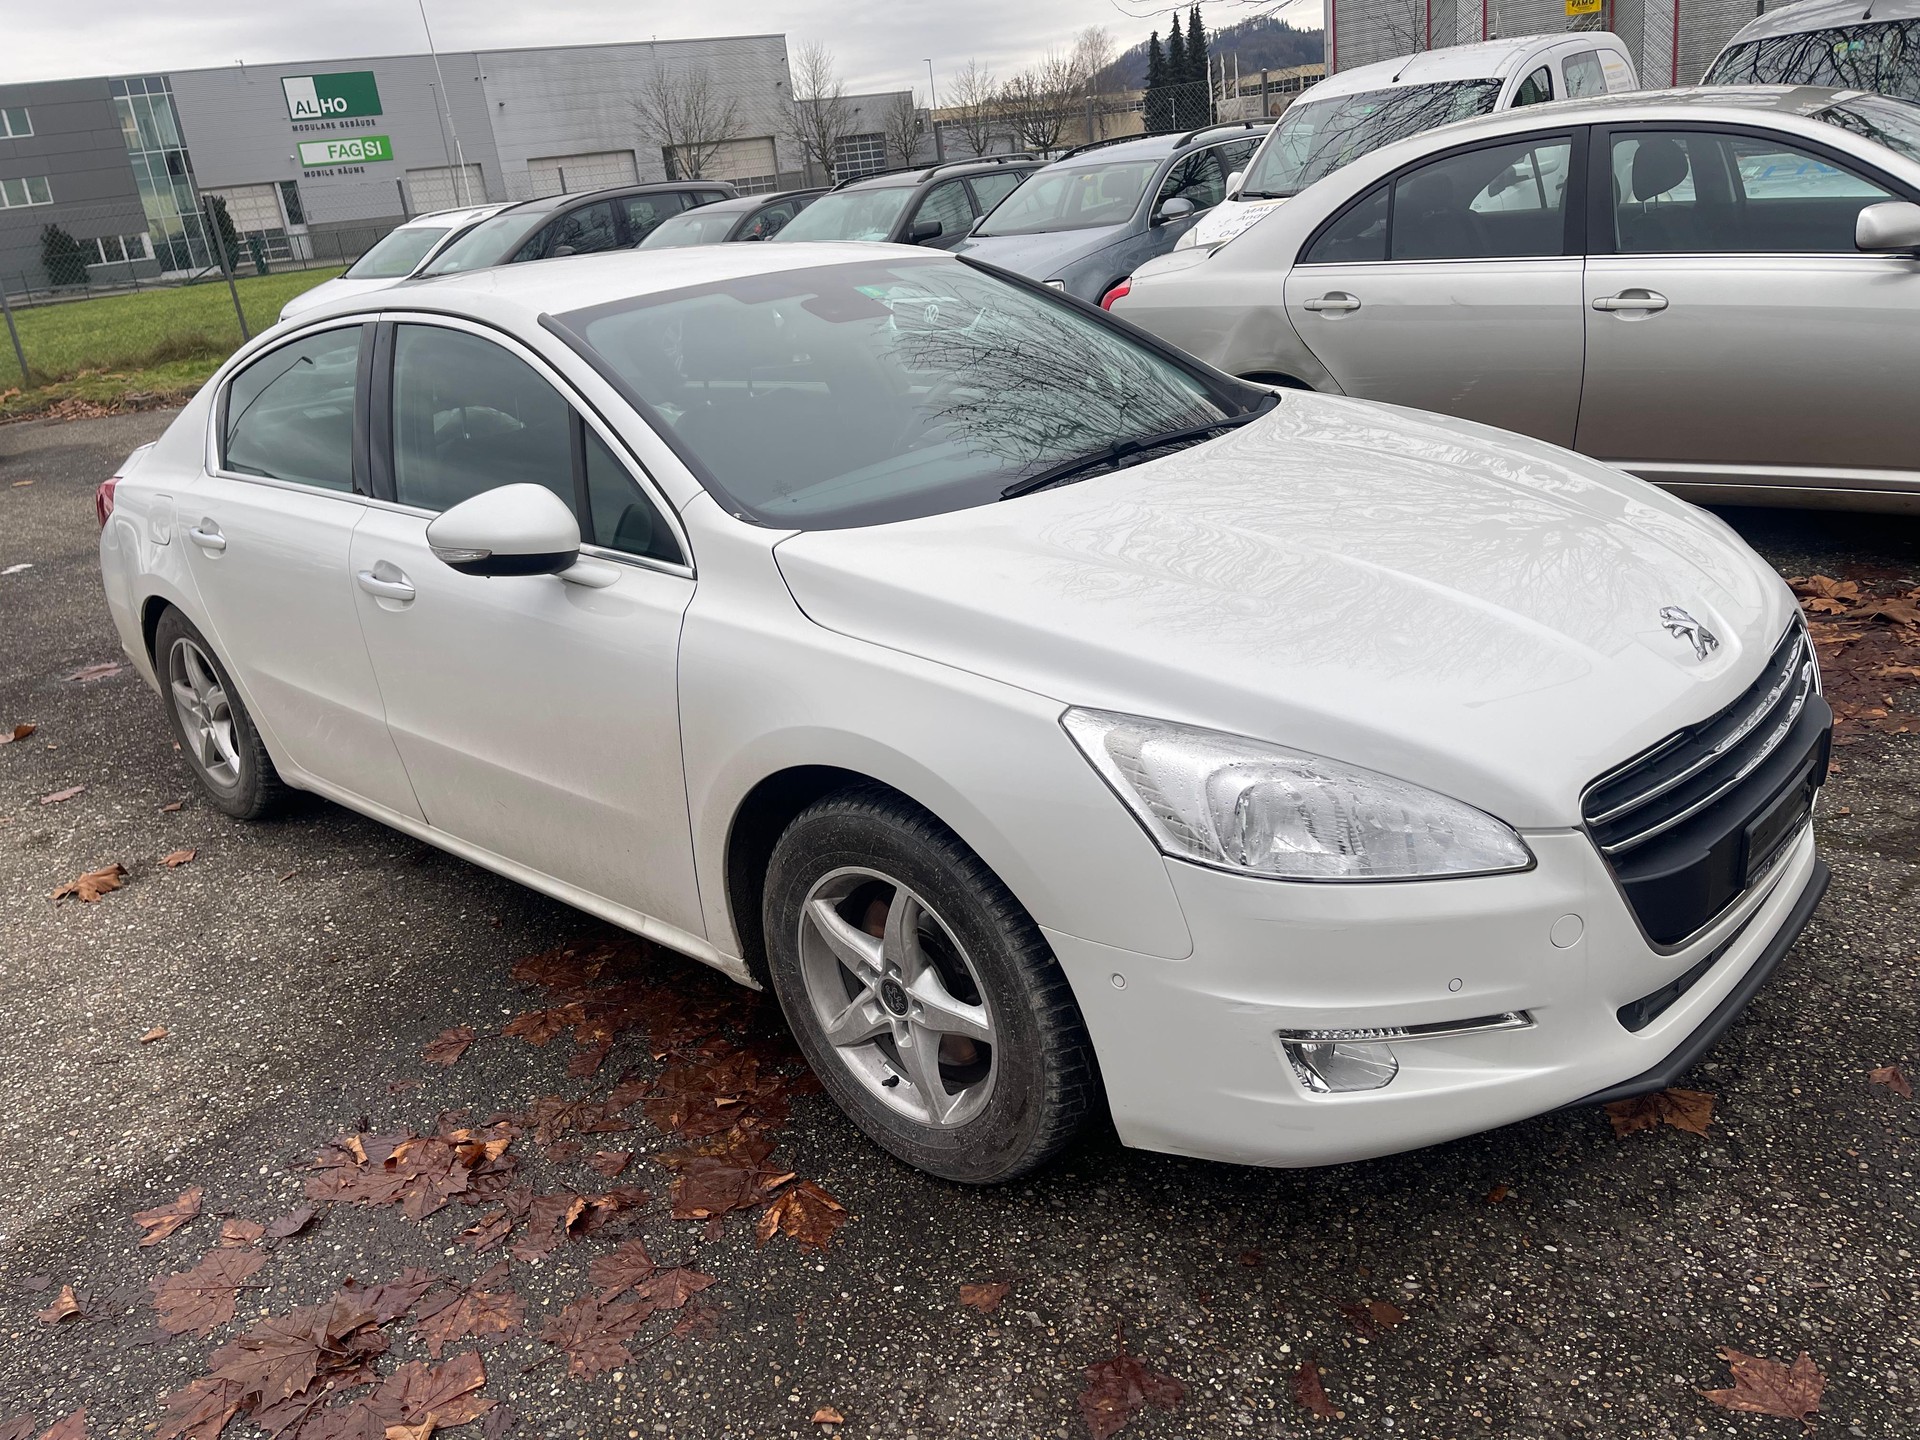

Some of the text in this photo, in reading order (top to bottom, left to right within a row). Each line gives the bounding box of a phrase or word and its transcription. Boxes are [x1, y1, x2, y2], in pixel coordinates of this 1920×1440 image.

[296, 97, 348, 115] ALHO
[292, 118, 376, 132] MODULARE GEBÄUDE
[327, 140, 383, 159] FAGSI
[303, 166, 365, 178] MOBILE RÄUME
